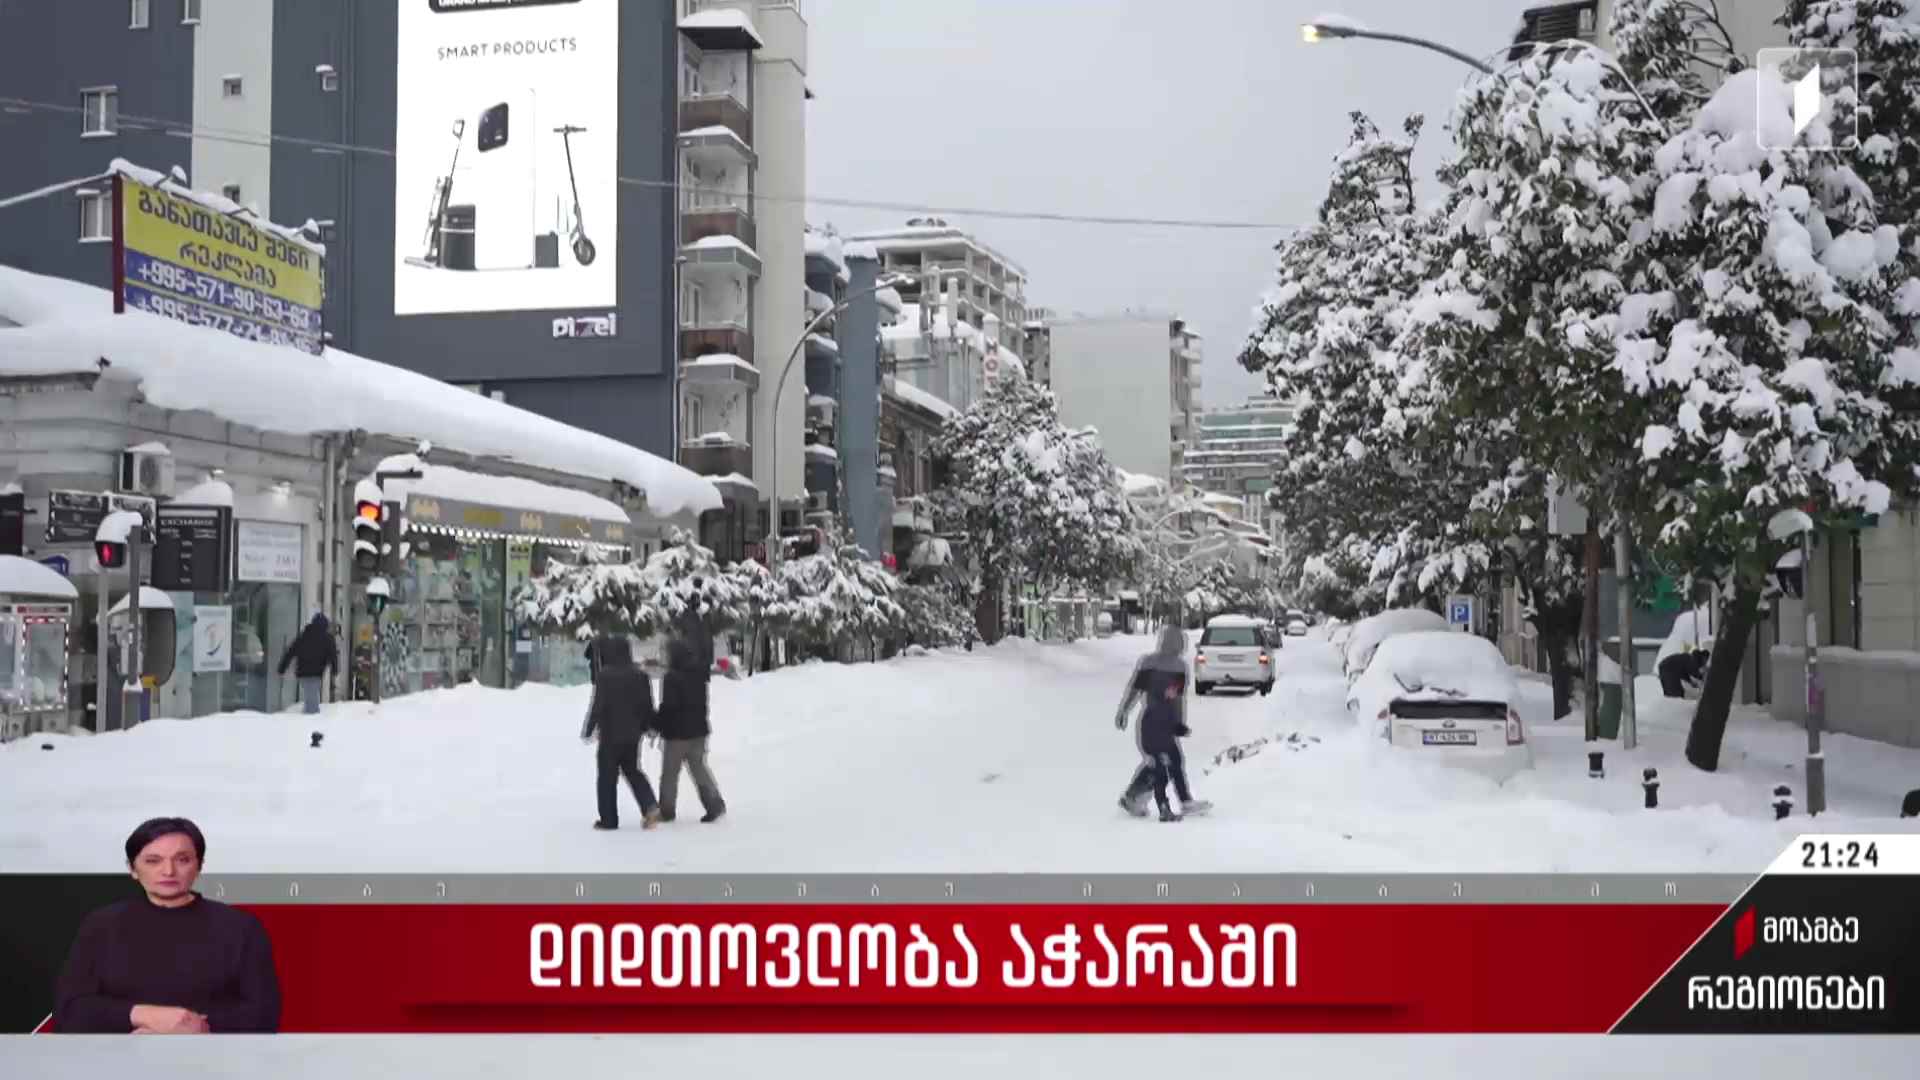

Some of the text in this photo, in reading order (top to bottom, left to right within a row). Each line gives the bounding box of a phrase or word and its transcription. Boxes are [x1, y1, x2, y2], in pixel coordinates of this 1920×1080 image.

[437, 37, 577, 61] SMART PRODUCTS
[138, 189, 310, 271] განათავსე შენი
[179, 240, 277, 289] რეკლამა
